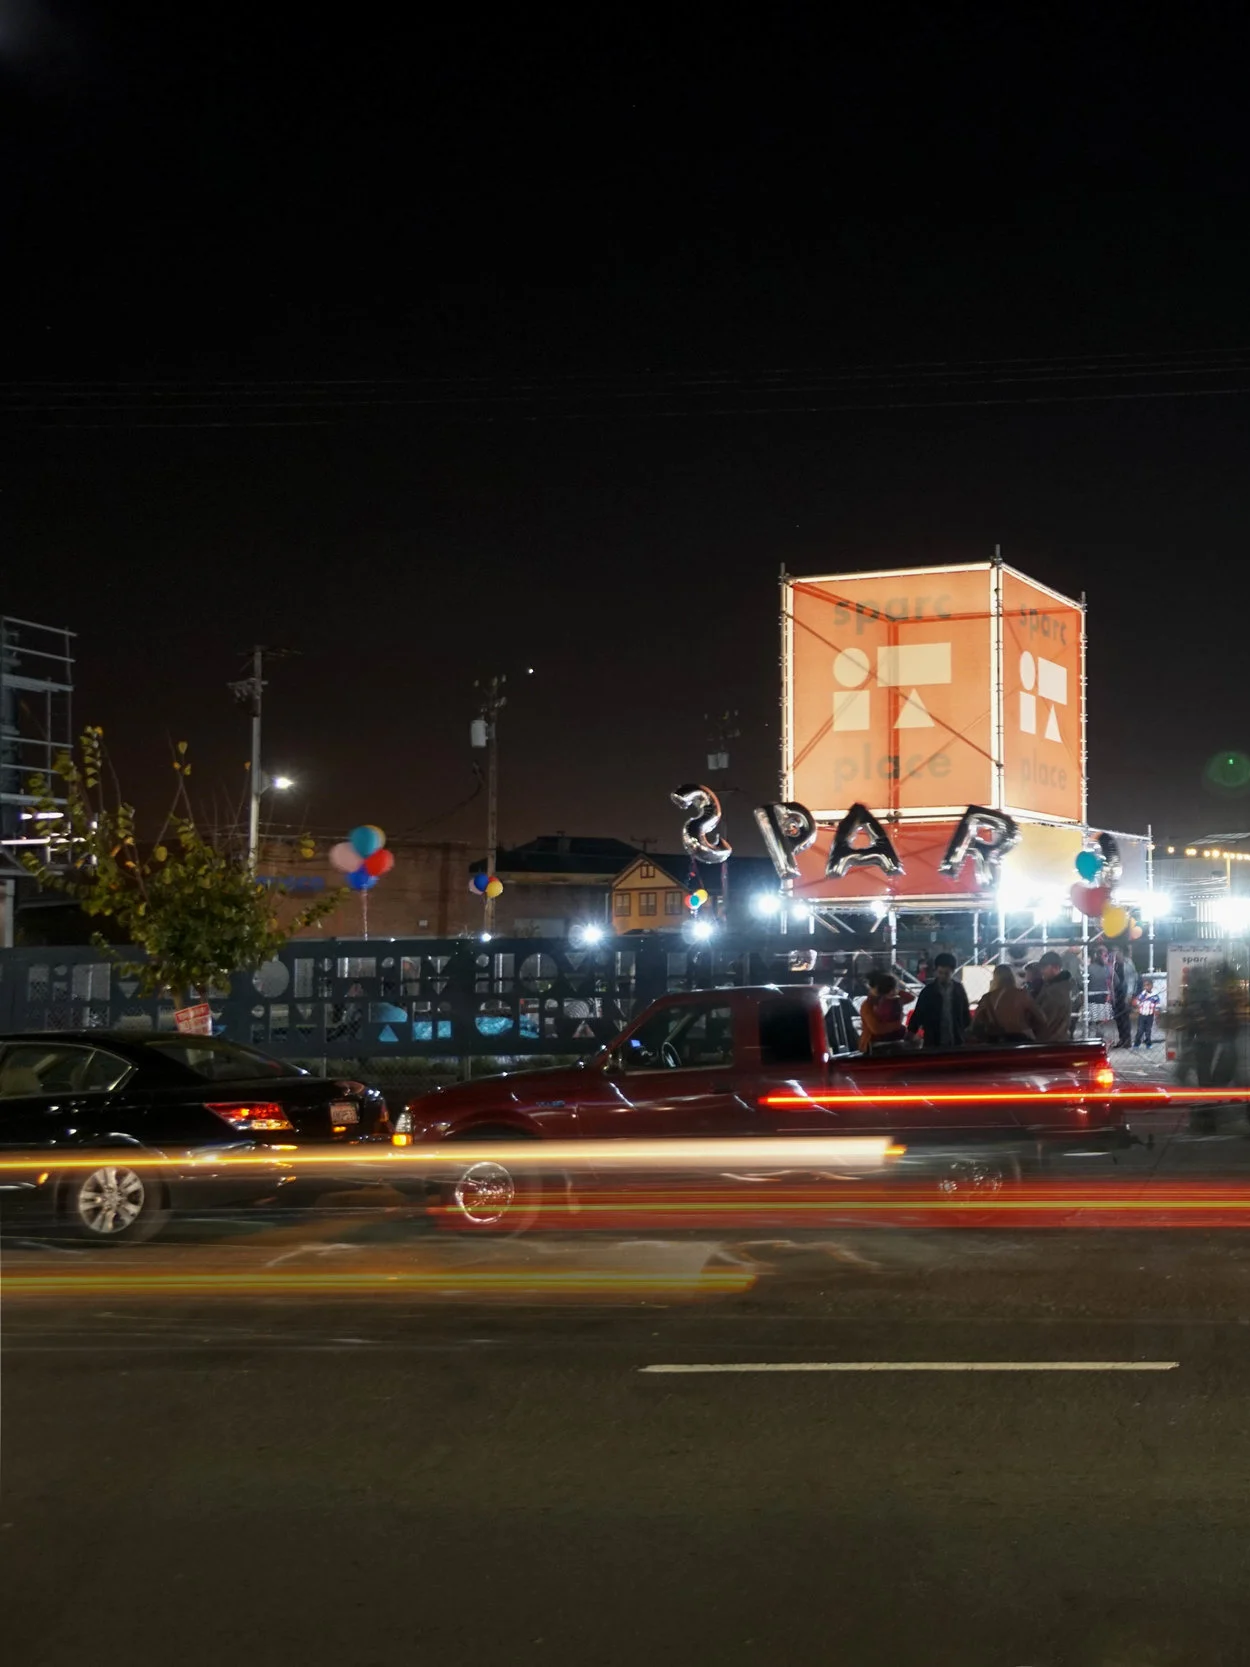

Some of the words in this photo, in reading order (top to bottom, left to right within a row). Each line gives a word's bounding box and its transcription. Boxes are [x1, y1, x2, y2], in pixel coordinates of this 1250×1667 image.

[834, 594, 952, 635] sparc
[1020, 604, 1067, 645] sparc
[834, 744, 952, 792] place
[1021, 749, 1067, 790] place
